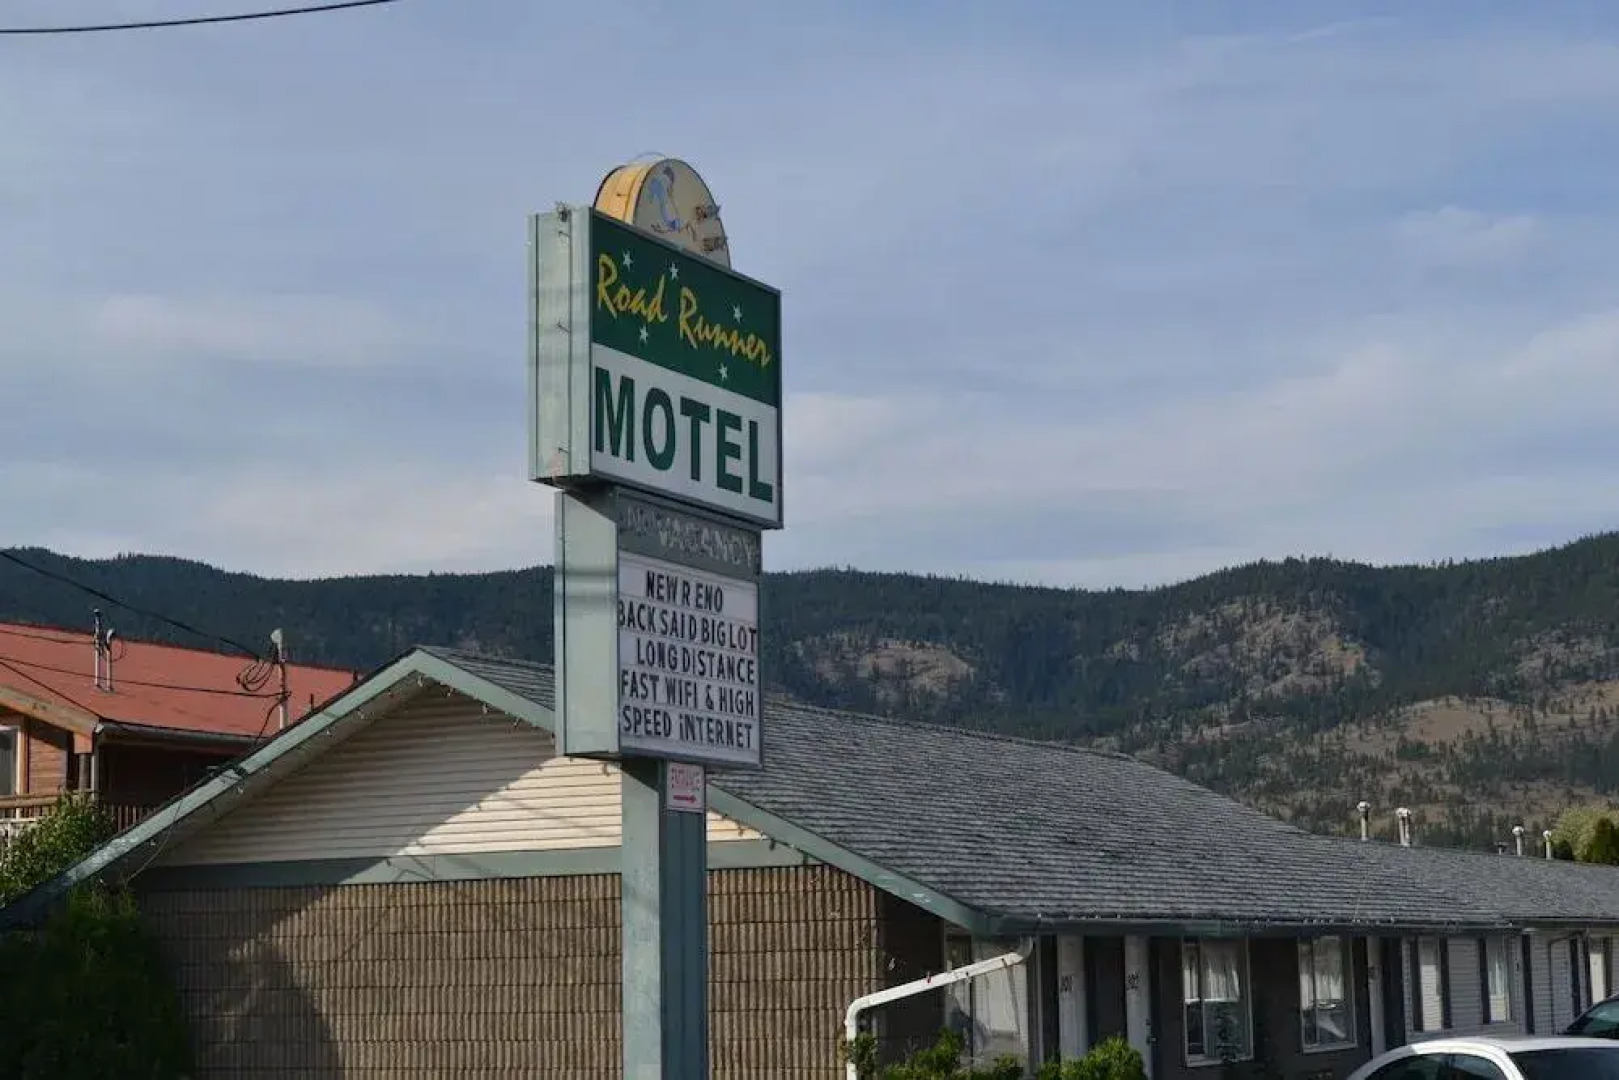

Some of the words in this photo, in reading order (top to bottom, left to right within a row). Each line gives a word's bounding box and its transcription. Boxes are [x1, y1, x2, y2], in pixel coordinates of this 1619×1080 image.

[597, 253, 668, 322] Road
[679, 286, 772, 368] Runner
[595, 366, 773, 503] MOTEL
[660, 609, 697, 640] SAID
[701, 617, 726, 646] BIG
[729, 623, 757, 653] LOT
[636, 637, 678, 671] LONG
[682, 647, 755, 686] DISTANCE
[621, 669, 659, 703] FAST
[665, 676, 697, 709] WIFI
[705, 685, 715, 711] &
[719, 687, 754, 717] HIGH
[622, 705, 671, 738] SPEED
